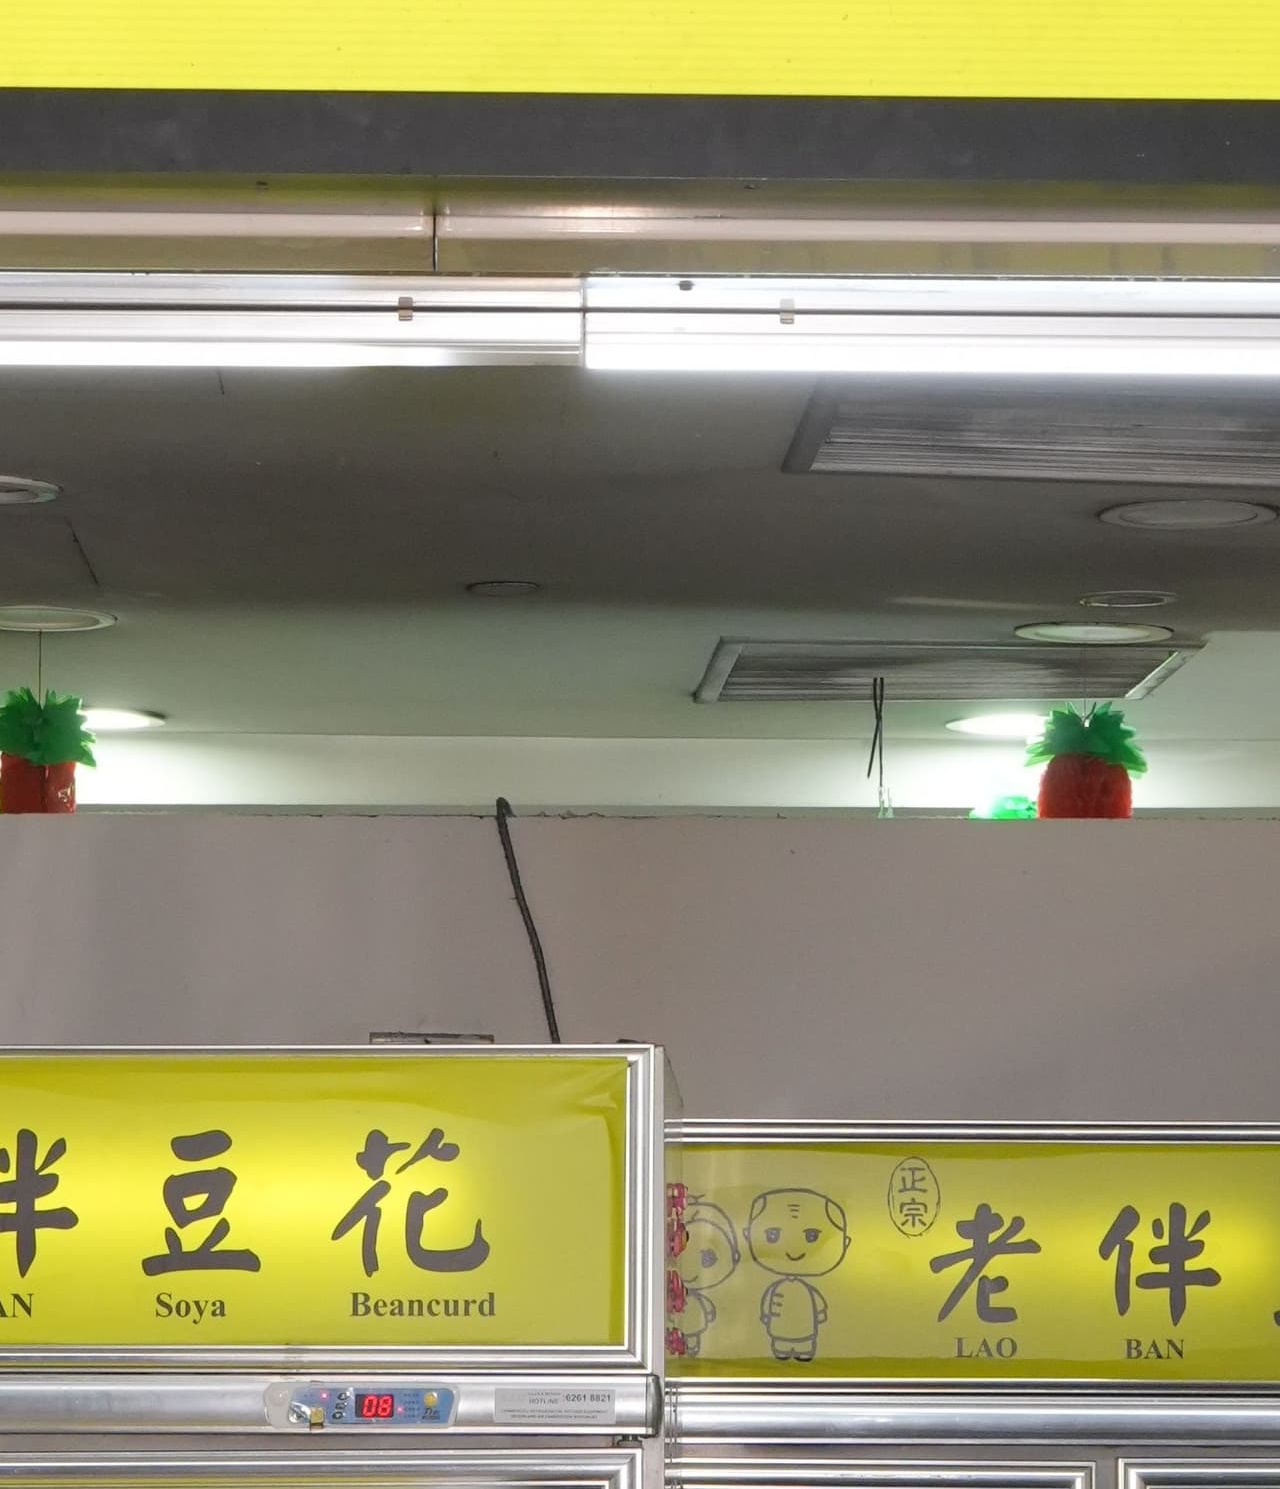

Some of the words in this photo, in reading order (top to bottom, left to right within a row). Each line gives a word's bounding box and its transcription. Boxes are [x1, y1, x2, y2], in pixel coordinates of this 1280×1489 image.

[897, 1166, 928, 1228] 正宗
[155, 1292, 227, 1325] Soya
[349, 1291, 497, 1318] Beancurd
[955, 1337, 1018, 1360] LAO
[1125, 1338, 1185, 1361] BAN
[361, 1395, 393, 1417] 08
